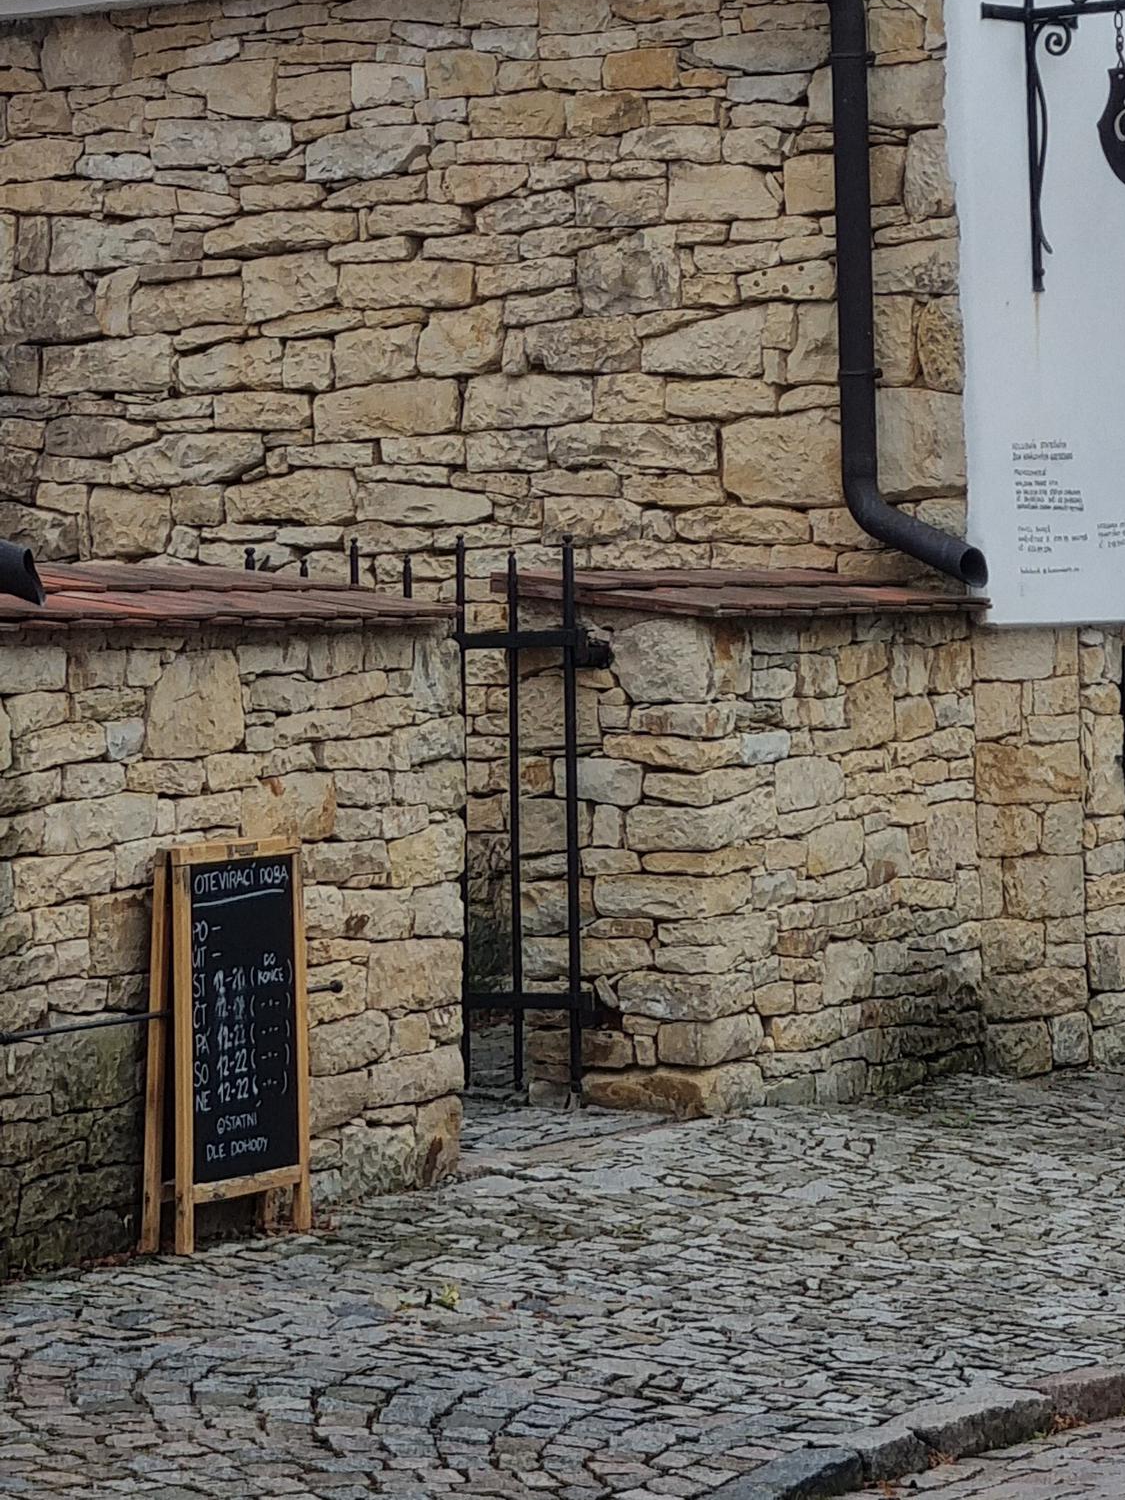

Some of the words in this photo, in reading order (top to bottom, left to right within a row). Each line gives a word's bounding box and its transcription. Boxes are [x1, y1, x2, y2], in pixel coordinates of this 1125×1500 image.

[194, 862, 257, 895] OTEVÍRACÍ
[259, 864, 290, 885] DOBA
[192, 920, 208, 942] PO
[195, 1027, 211, 1056] PÁ
[194, 1061, 209, 1087] SO
[195, 1090, 212, 1112] NE
[217, 1077, 249, 1103] 12-22
[206, 1142, 226, 1162] DLE
[231, 1136, 268, 1156] DOHODY
